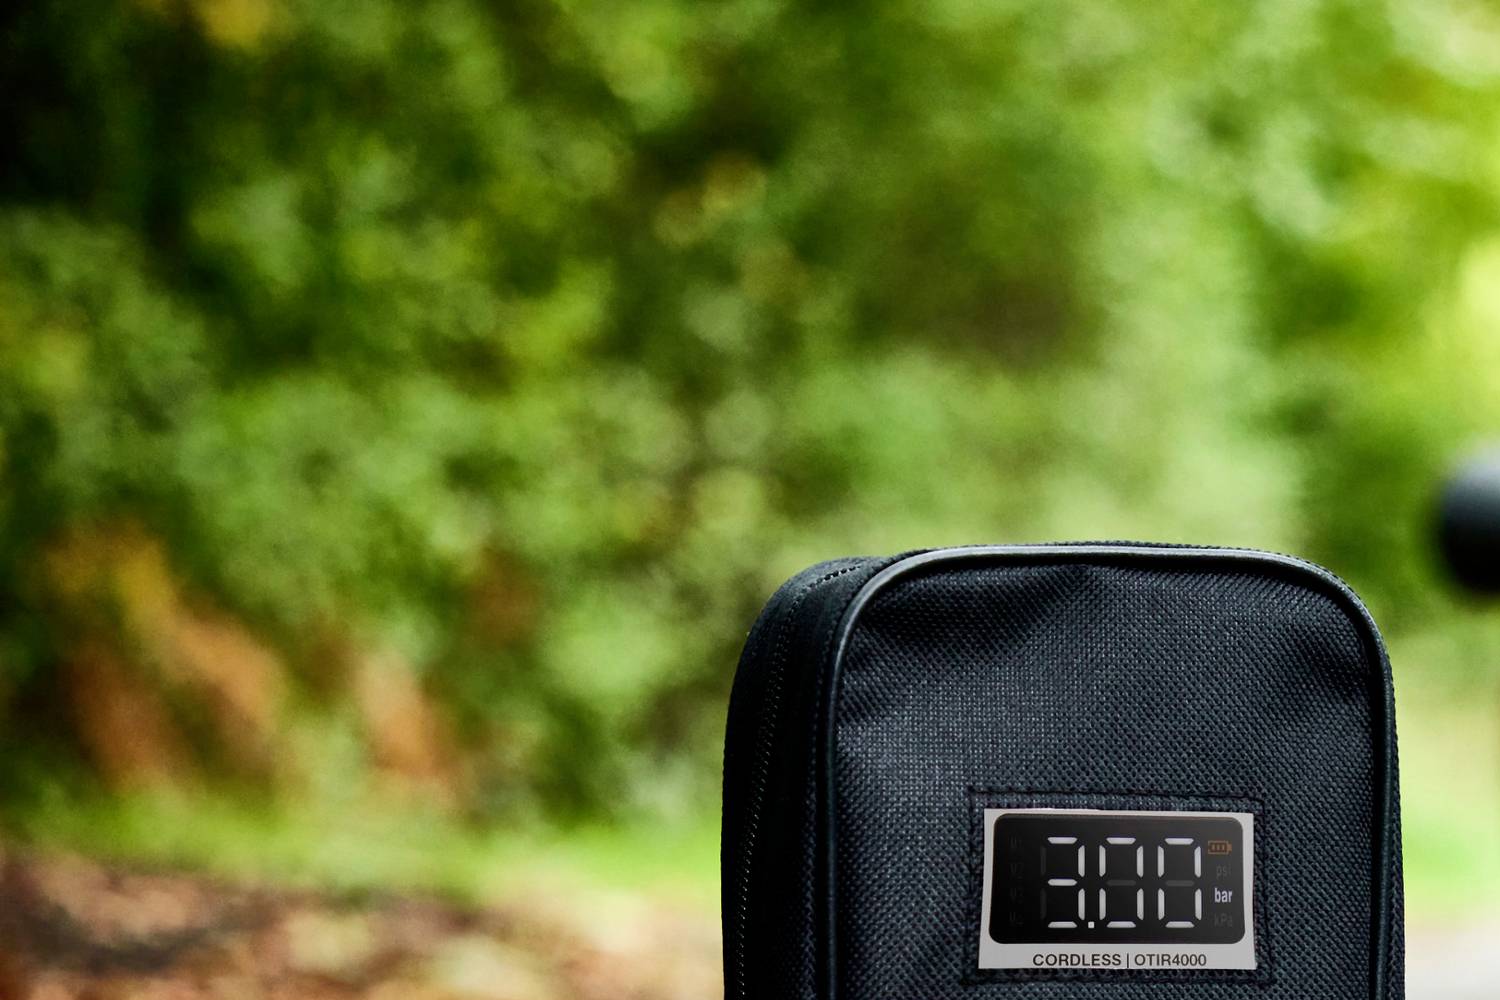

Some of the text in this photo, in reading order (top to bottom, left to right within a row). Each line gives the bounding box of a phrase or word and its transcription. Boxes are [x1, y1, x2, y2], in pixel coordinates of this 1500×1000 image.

[1047, 837, 1202, 929] 3.00
[1214, 887, 1233, 903] bar
[1032, 953, 1122, 967] CORDLESS
[1134, 953, 1207, 967] OTIR4000
